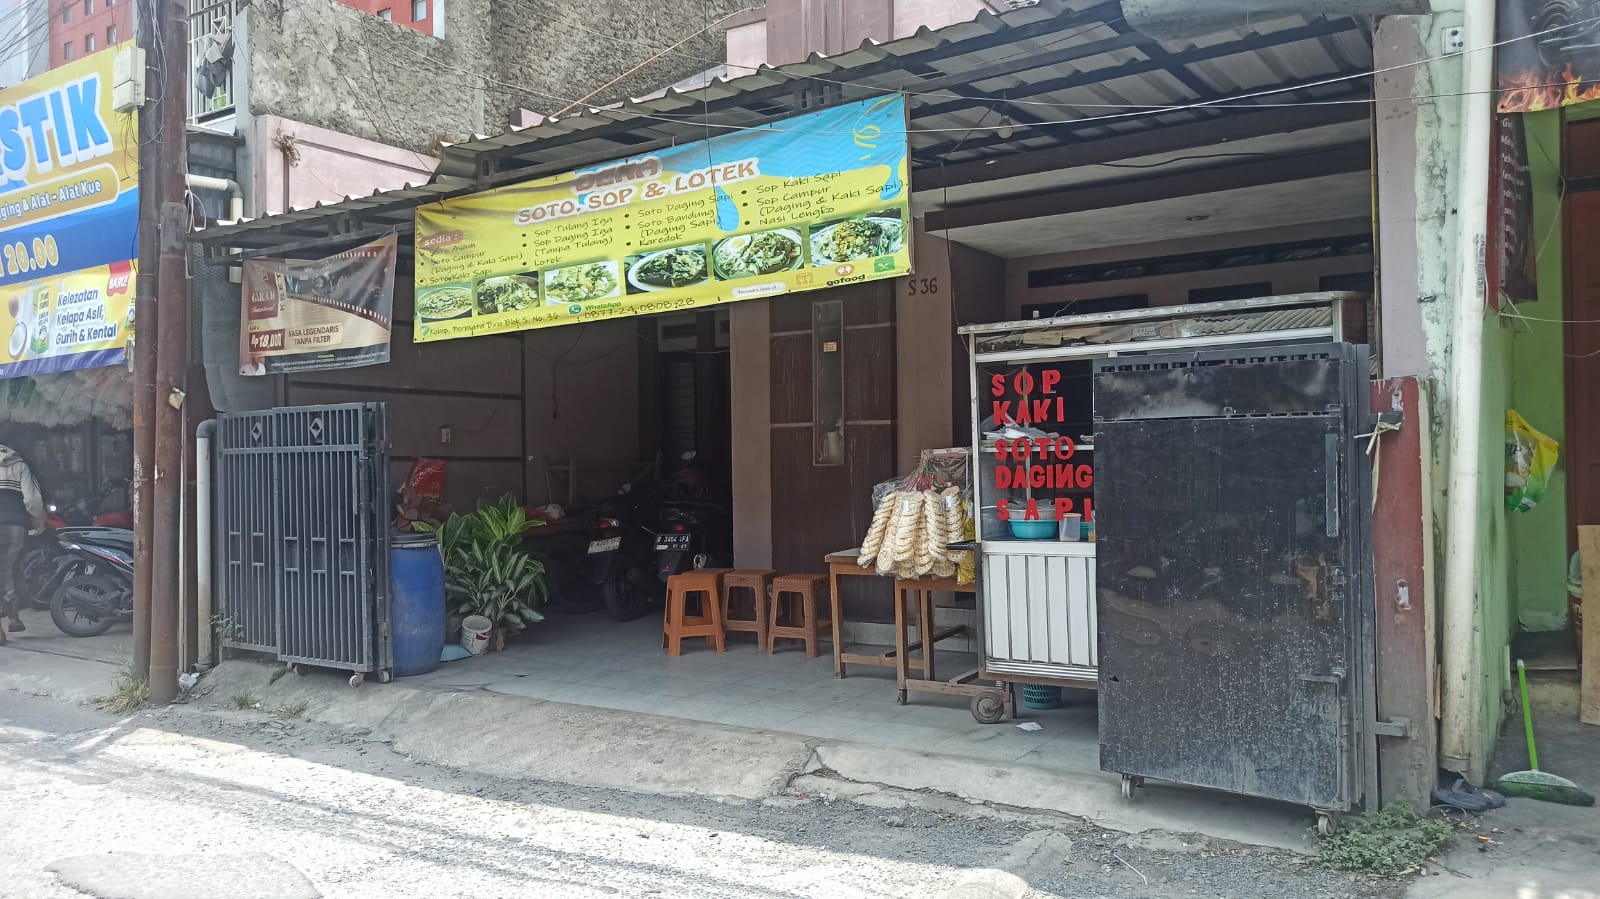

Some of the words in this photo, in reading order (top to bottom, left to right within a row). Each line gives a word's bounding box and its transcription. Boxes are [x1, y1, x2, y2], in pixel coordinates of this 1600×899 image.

[0, 77, 109, 172] STIK
[588, 188, 633, 209] SOP
[645, 182, 665, 198] &
[675, 161, 754, 192] LOTEK
[756, 184, 779, 194] Sop
[783, 176, 809, 187] Kaki
[813, 171, 841, 182] Sapi
[23, 199, 30, 213] &
[31, 193, 51, 210] Alat
[59, 185, 80, 203] Alat
[81, 180, 102, 199] Kue
[637, 208, 662, 217] Soto
[666, 199, 705, 211] Daging
[708, 192, 734, 203] Sapi
[756, 196, 778, 206] Sop
[759, 200, 811, 216] (Daging
[816, 197, 827, 205] &
[832, 190, 860, 201] Kaki
[866, 179, 904, 194] Sapi)
[637, 220, 662, 229] Soto
[666, 209, 715, 223] Bandung
[760, 216, 786, 226] Nasi
[791, 205, 834, 220] Lengko
[534, 229, 551, 237] Sop
[554, 222, 588, 232] Tulang
[591, 217, 613, 226] Iga
[534, 239, 551, 248] Sop
[554, 232, 588, 243] Daging
[592, 227, 613, 236] Iga
[640, 224, 686, 239] (Daging
[452, 243, 476, 252] Ayam
[535, 245, 570, 257] (Tanpa
[573, 236, 613, 248] Tulang)
[639, 233, 683, 246] Karedok
[477, 259, 496, 267] Kaki
[499, 252, 523, 263] Sapi)
[534, 256, 561, 266] Lotek
[453, 272, 470, 281] Kaki
[826, 274, 866, 287] gofood
[908, 279, 917, 296] S
[920, 277, 938, 294] 36
[58, 289, 99, 307] Kelezatan
[585, 300, 622, 312] WhatsApp
[56, 310, 85, 328] Kelapa
[86, 304, 104, 321] Asli,
[55, 330, 78, 345] Gurih
[79, 329, 86, 341] &
[88, 323, 117, 341] Kental
[288, 328, 302, 337] RASA
[303, 325, 339, 336] LEGENDARIS
[294, 335, 312, 345] TANPA
[313, 335, 331, 344] FILTER
[991, 370, 1061, 397] SOP
[993, 397, 1065, 425] KAKI
[994, 435, 1075, 463] SOTO
[995, 464, 1094, 489] DAGING
[996, 497, 1094, 522] SAPI
